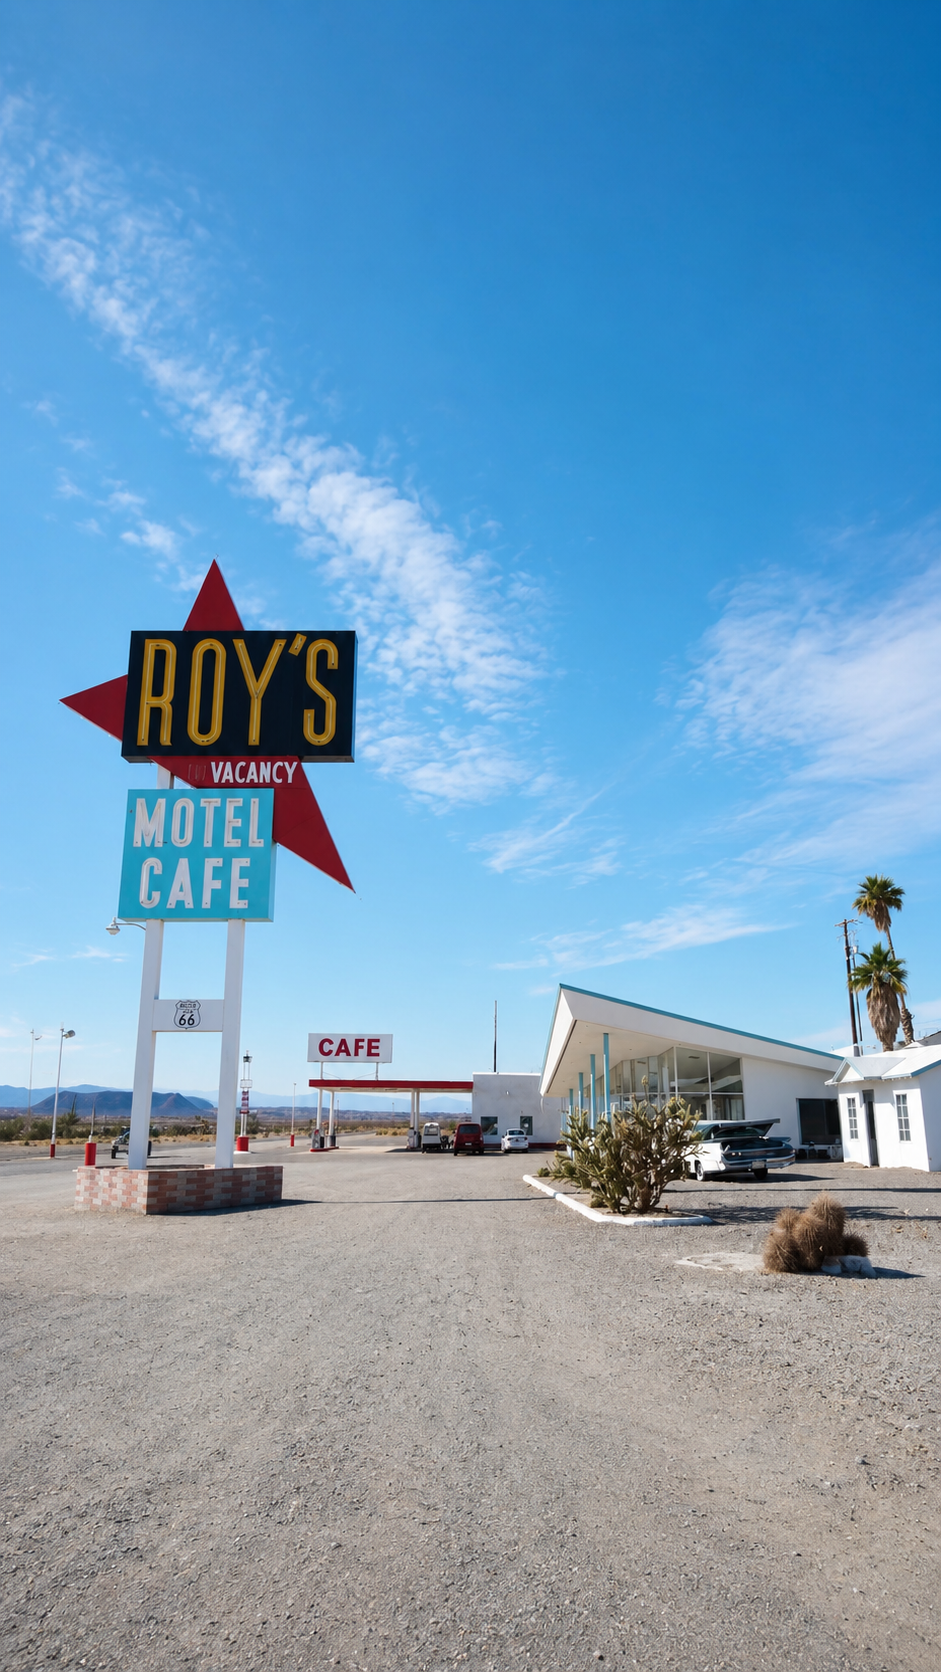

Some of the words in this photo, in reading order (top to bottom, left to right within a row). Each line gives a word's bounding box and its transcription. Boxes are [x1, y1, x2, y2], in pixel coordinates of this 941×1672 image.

[137, 633, 338, 746] ROY'S
[211, 761, 298, 783] VACANCY
[133, 798, 264, 847] MOTEL
[139, 857, 251, 908] CAFE
[179, 1013, 195, 1026] 66
[318, 1038, 380, 1057] CAFE
